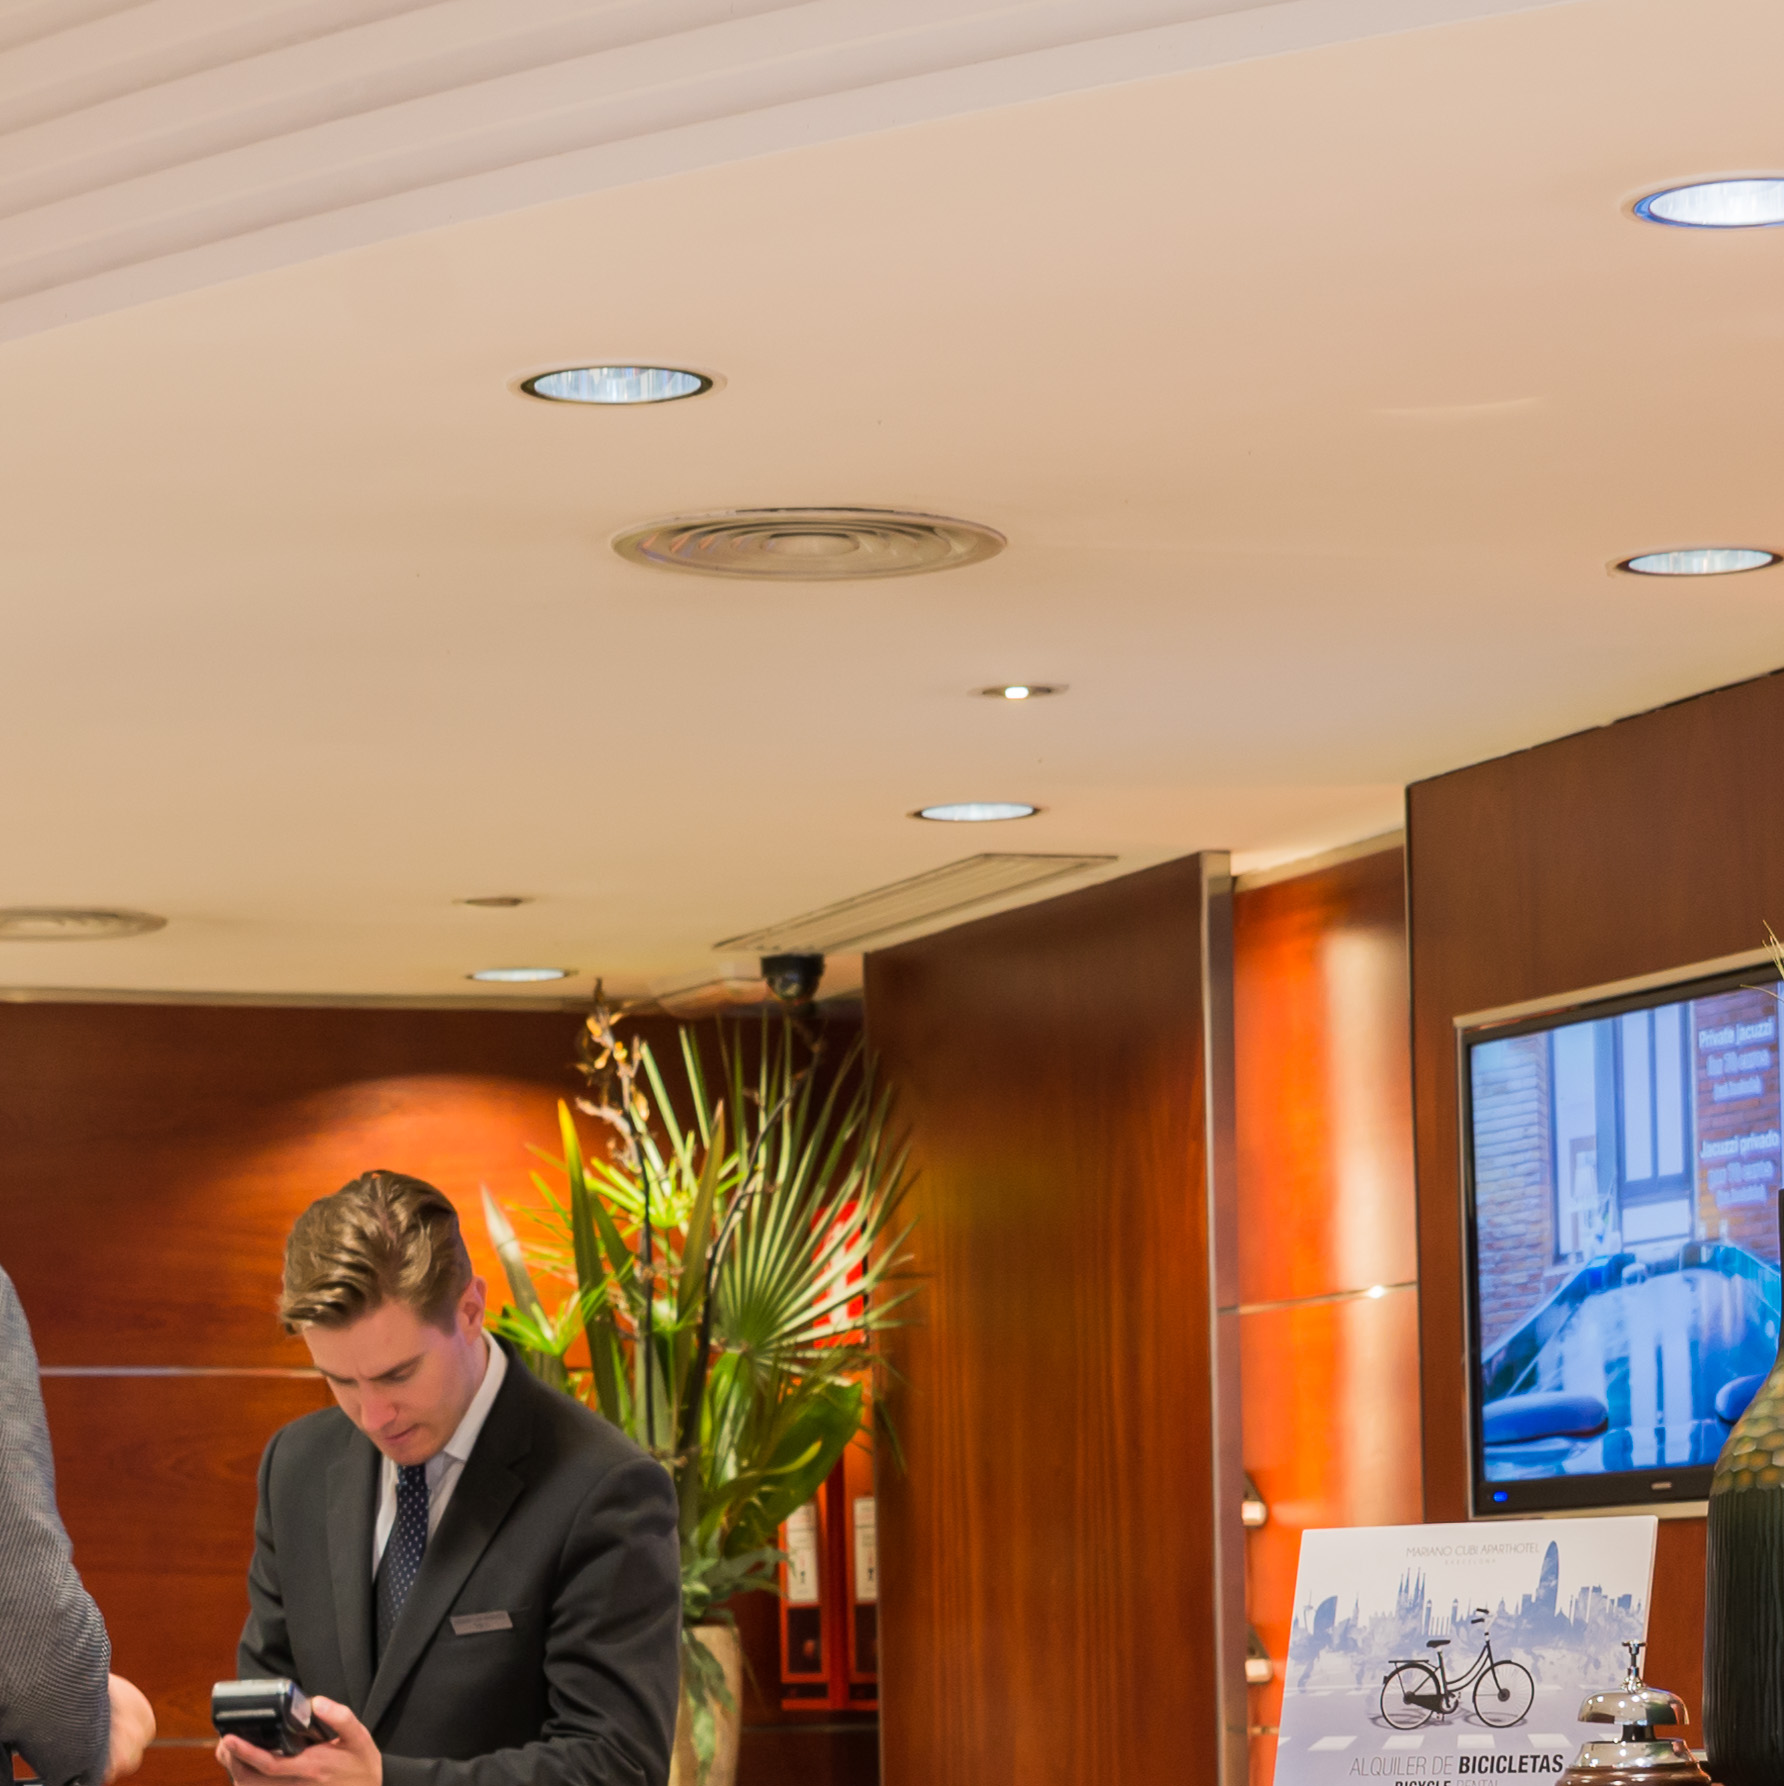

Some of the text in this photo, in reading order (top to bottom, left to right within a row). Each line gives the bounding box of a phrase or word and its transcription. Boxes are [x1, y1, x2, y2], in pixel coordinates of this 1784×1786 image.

[1698, 1027, 1735, 1049] Private
[1739, 1129, 1779, 1156] privado
[1406, 1545, 1452, 1557] MARIANO
[1481, 1542, 1540, 1554] APARTHOTEL
[1349, 1754, 1564, 1777] ALQUILER DE BICICLETAS
